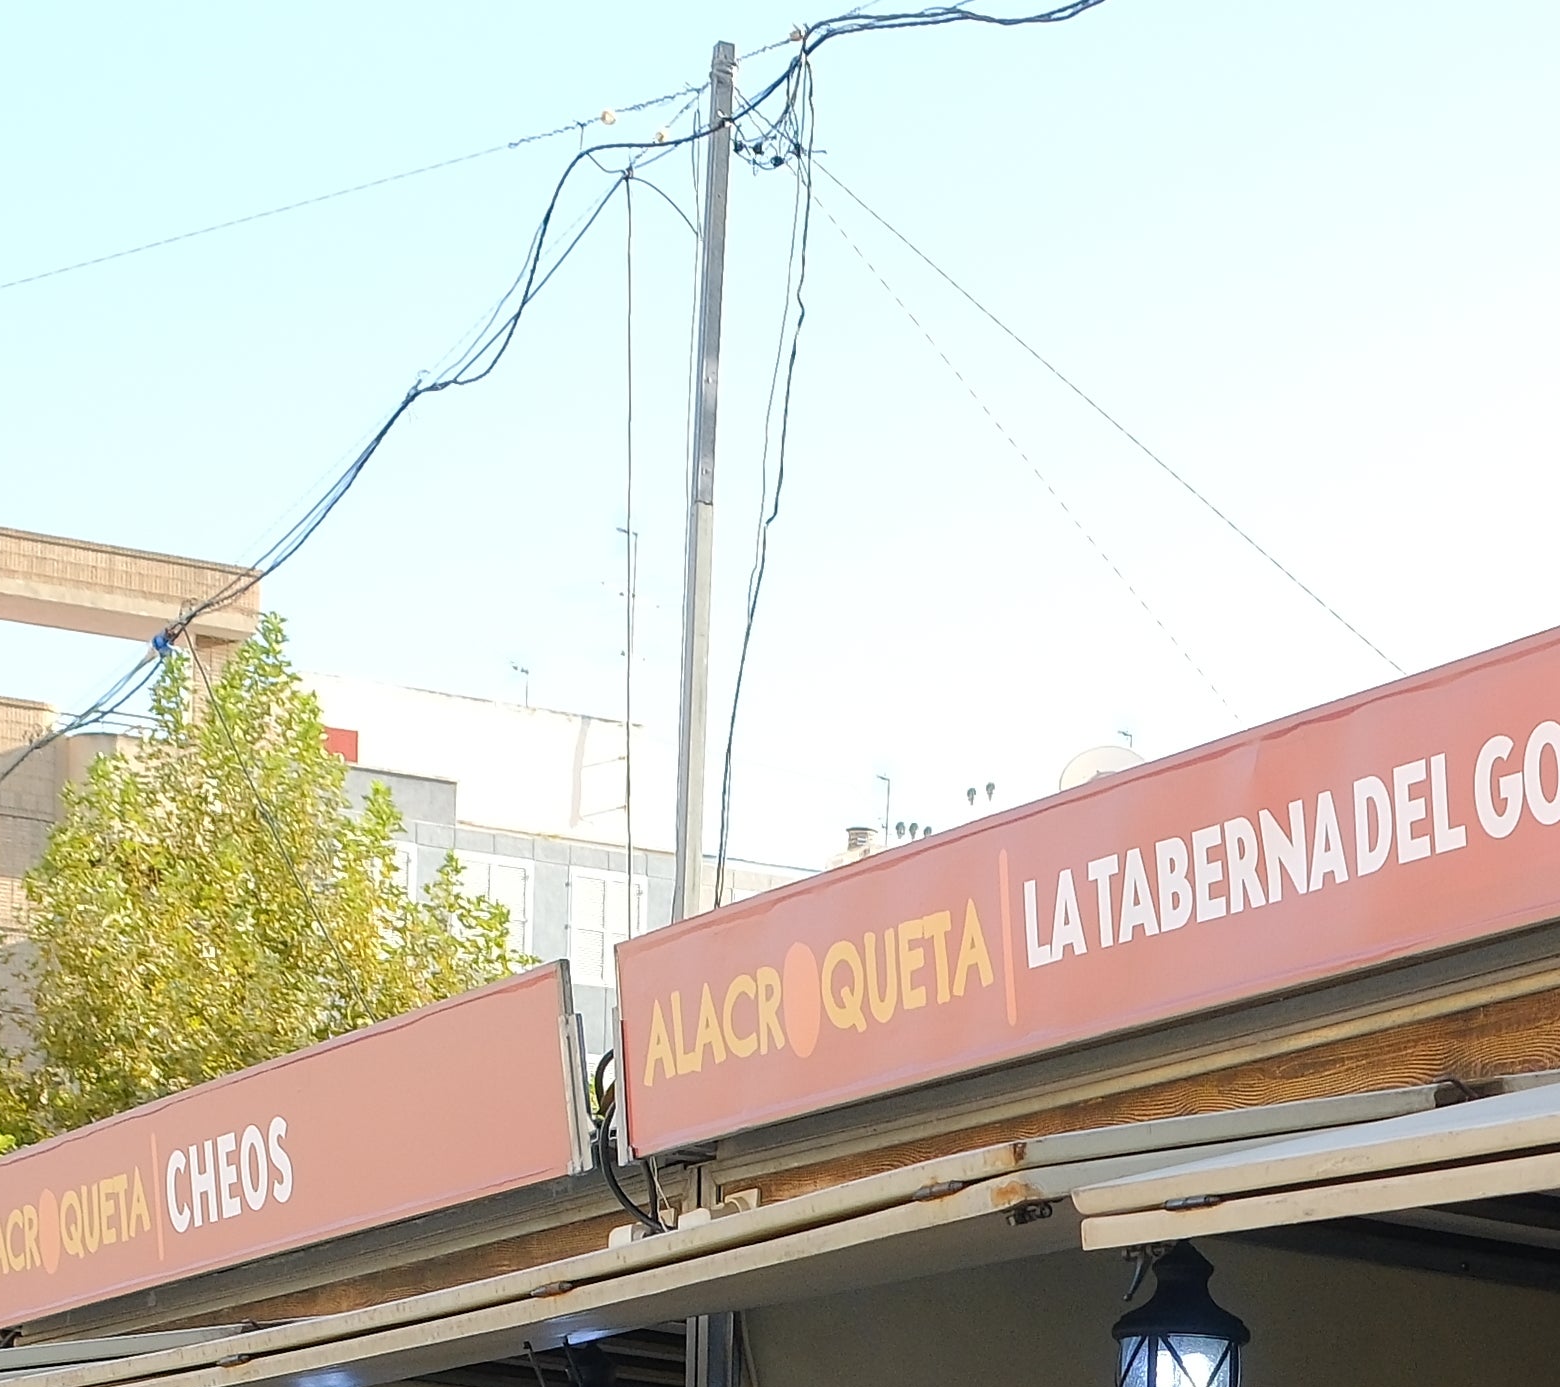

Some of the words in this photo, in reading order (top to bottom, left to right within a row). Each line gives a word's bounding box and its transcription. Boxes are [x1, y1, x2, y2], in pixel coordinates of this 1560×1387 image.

[644, 896, 994, 1088] ALACROQUETA
[1023, 875, 1087, 970] LA
[1087, 790, 1344, 943] TABERNA
[1351, 754, 1466, 874] DEL
[166, 1116, 293, 1233] CHEOS
